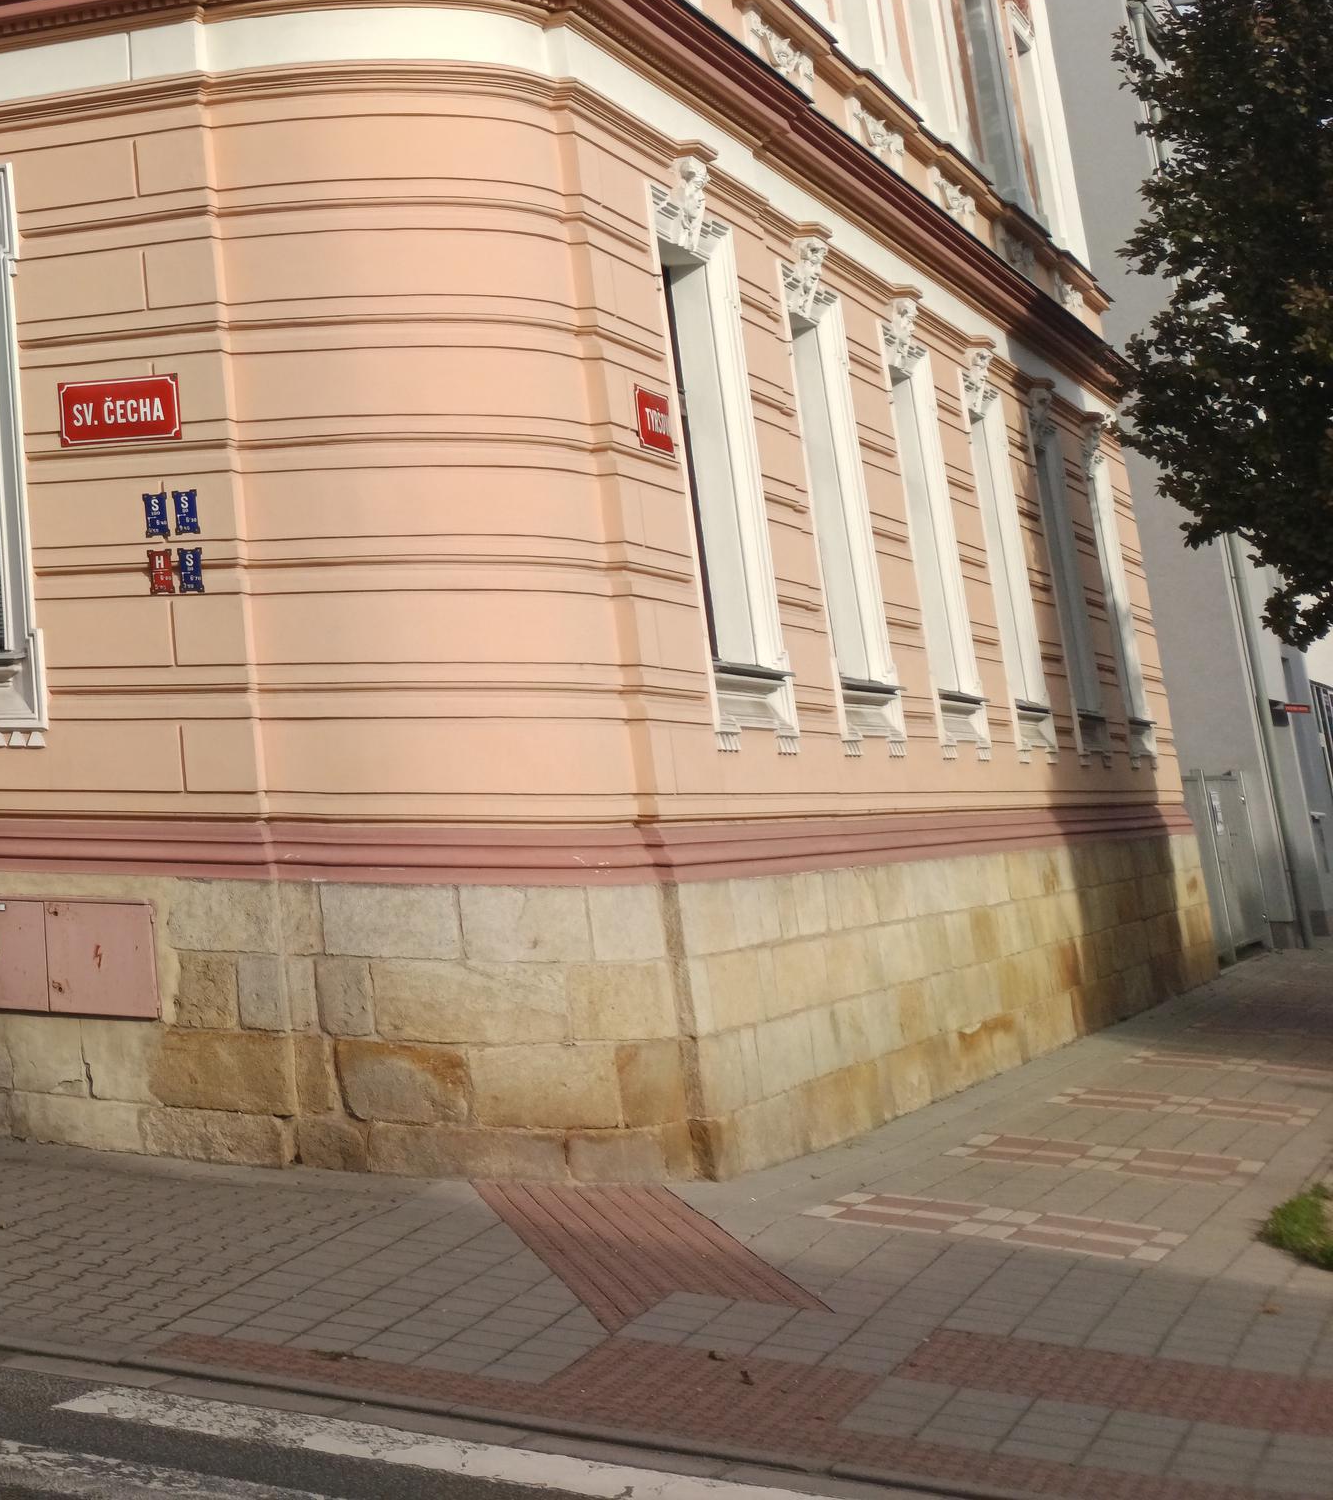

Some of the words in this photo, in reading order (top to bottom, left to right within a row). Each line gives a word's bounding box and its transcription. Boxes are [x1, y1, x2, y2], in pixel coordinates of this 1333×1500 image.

[73, 403, 99, 427] SV.
[103, 397, 165, 424] ČECHA
[155, 555, 164, 569] H
